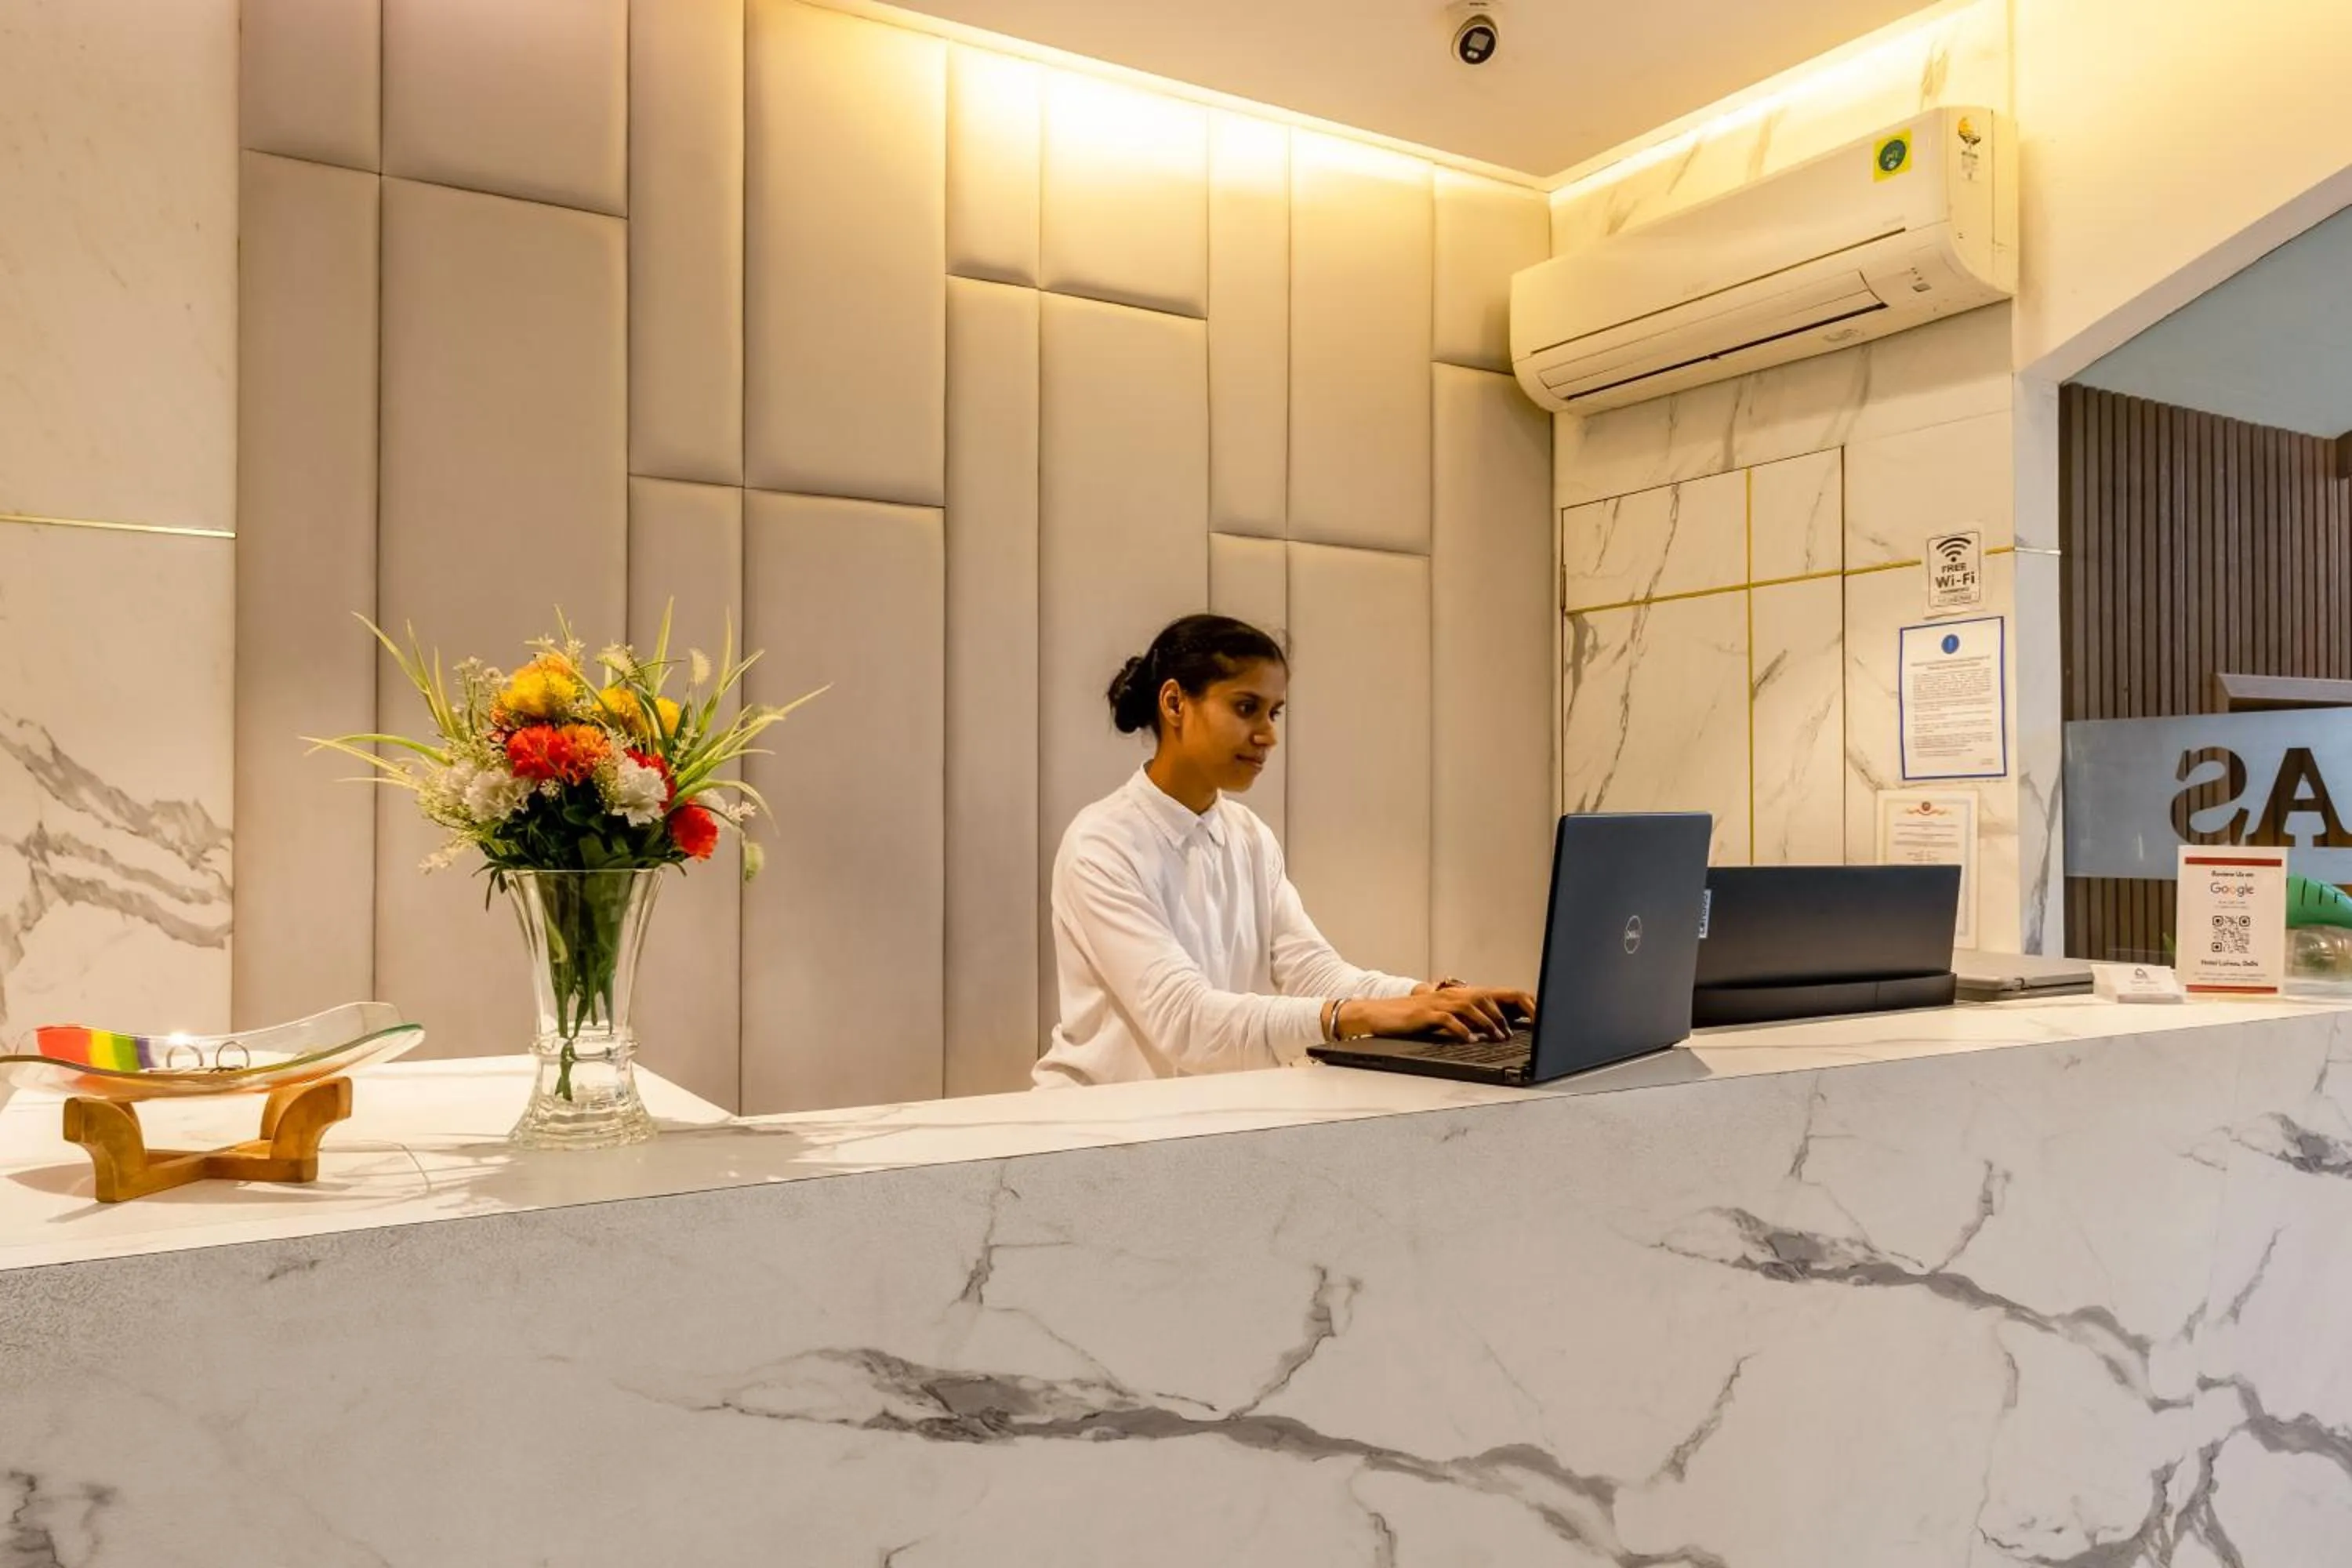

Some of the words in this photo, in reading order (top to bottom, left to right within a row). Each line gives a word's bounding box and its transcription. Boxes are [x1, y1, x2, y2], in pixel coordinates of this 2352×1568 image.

[1941, 562, 1966, 573] FREE
[1935, 571, 1975, 588] Wi-Fi
[2210, 882, 2254, 897] Google
